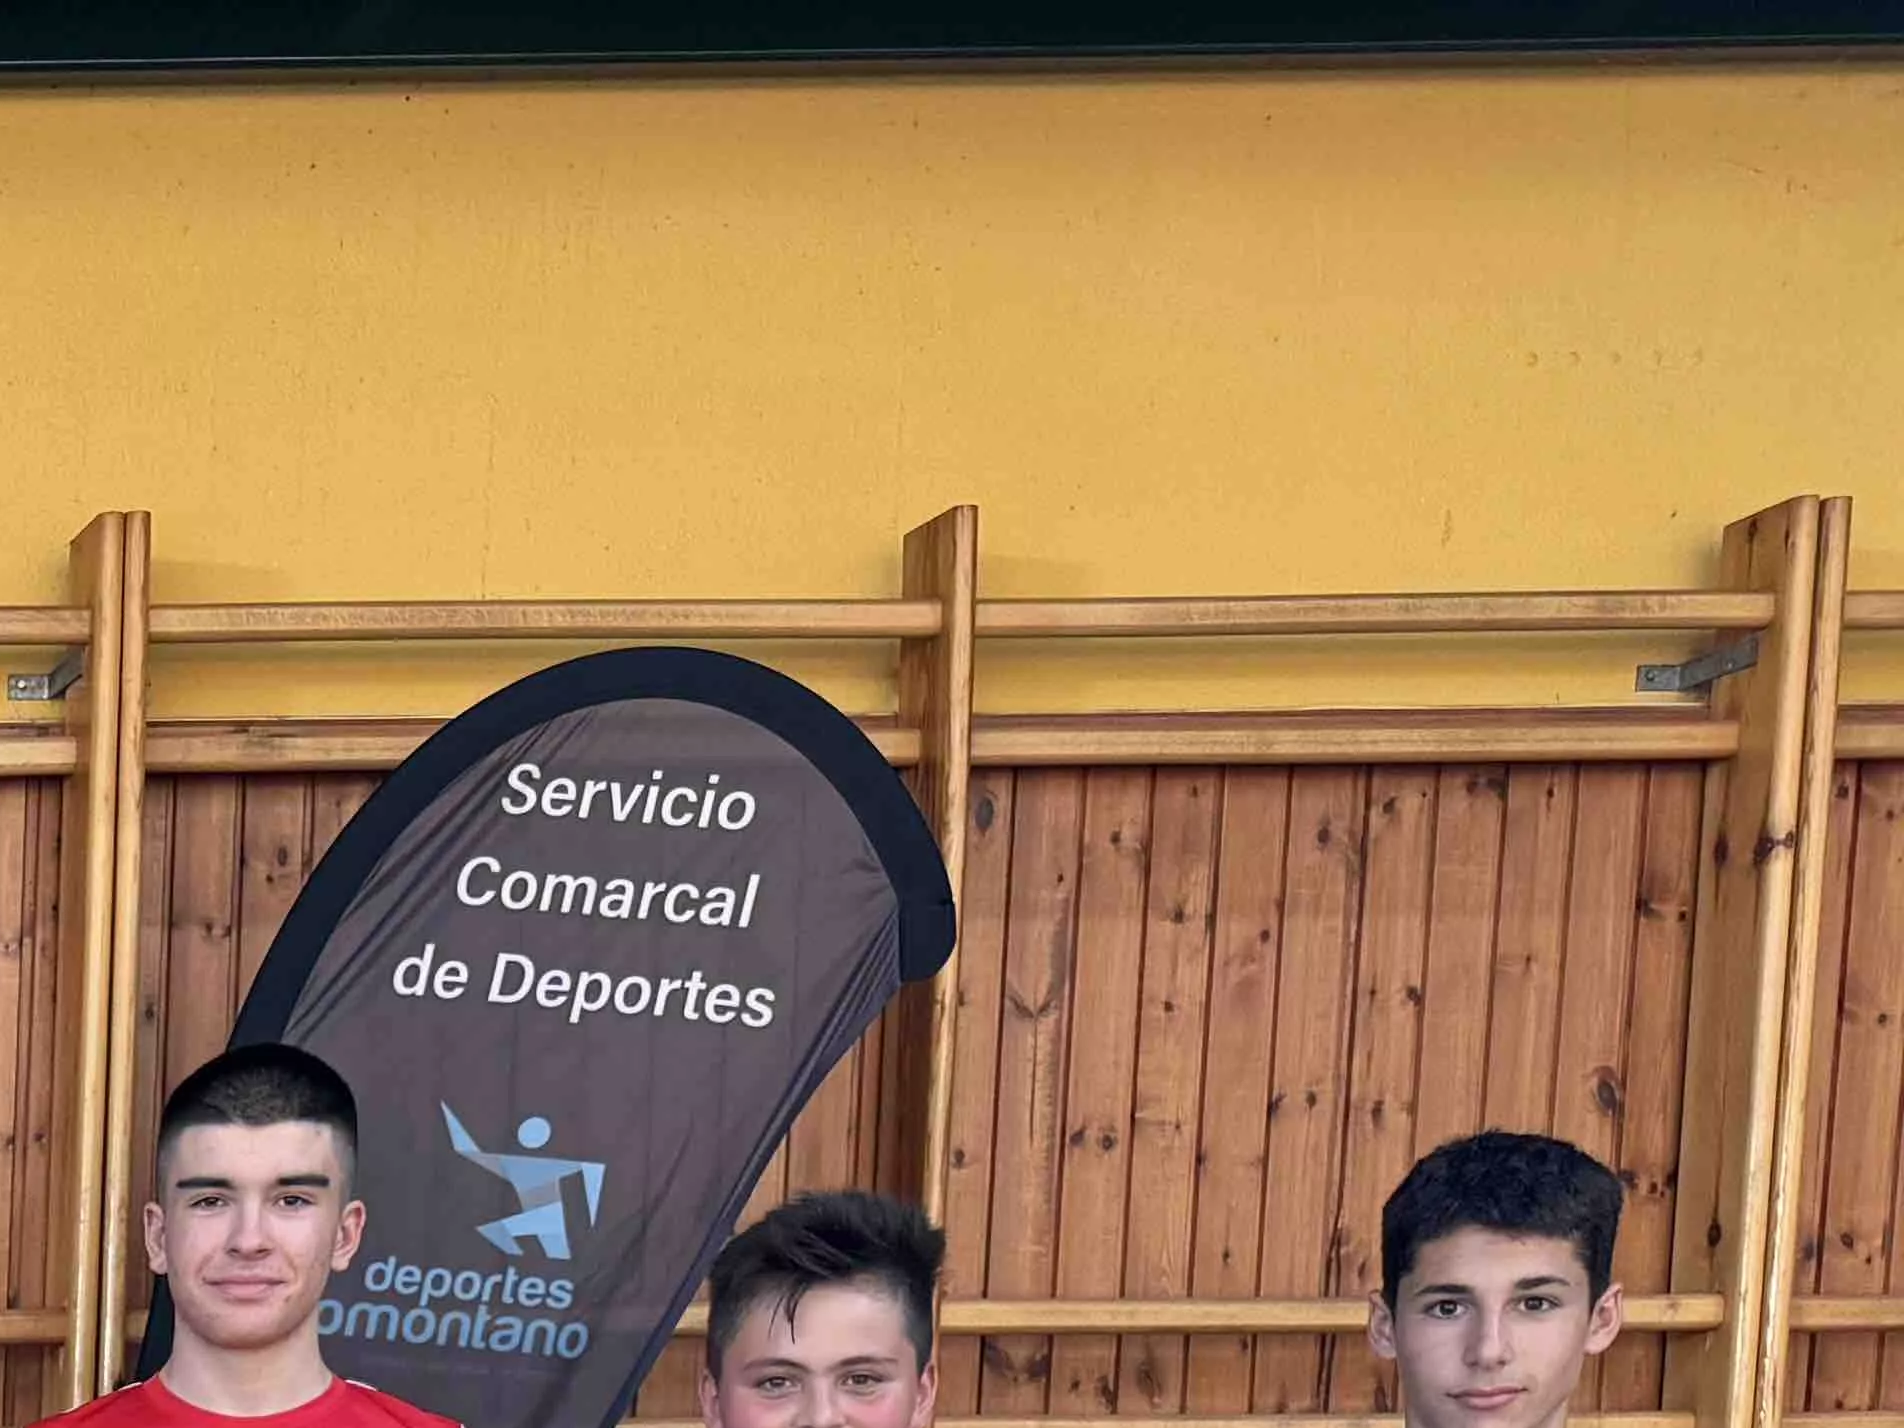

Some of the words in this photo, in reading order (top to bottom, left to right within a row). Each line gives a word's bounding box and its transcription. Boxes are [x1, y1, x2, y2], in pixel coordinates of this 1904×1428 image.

[501, 763, 755, 830] Servicio
[456, 856, 761, 928] Comarcal
[392, 943, 469, 1000] de
[487, 952, 776, 1028] Deportes
[364, 1256, 575, 1309] deportes
[317, 1298, 589, 1359] omontano
